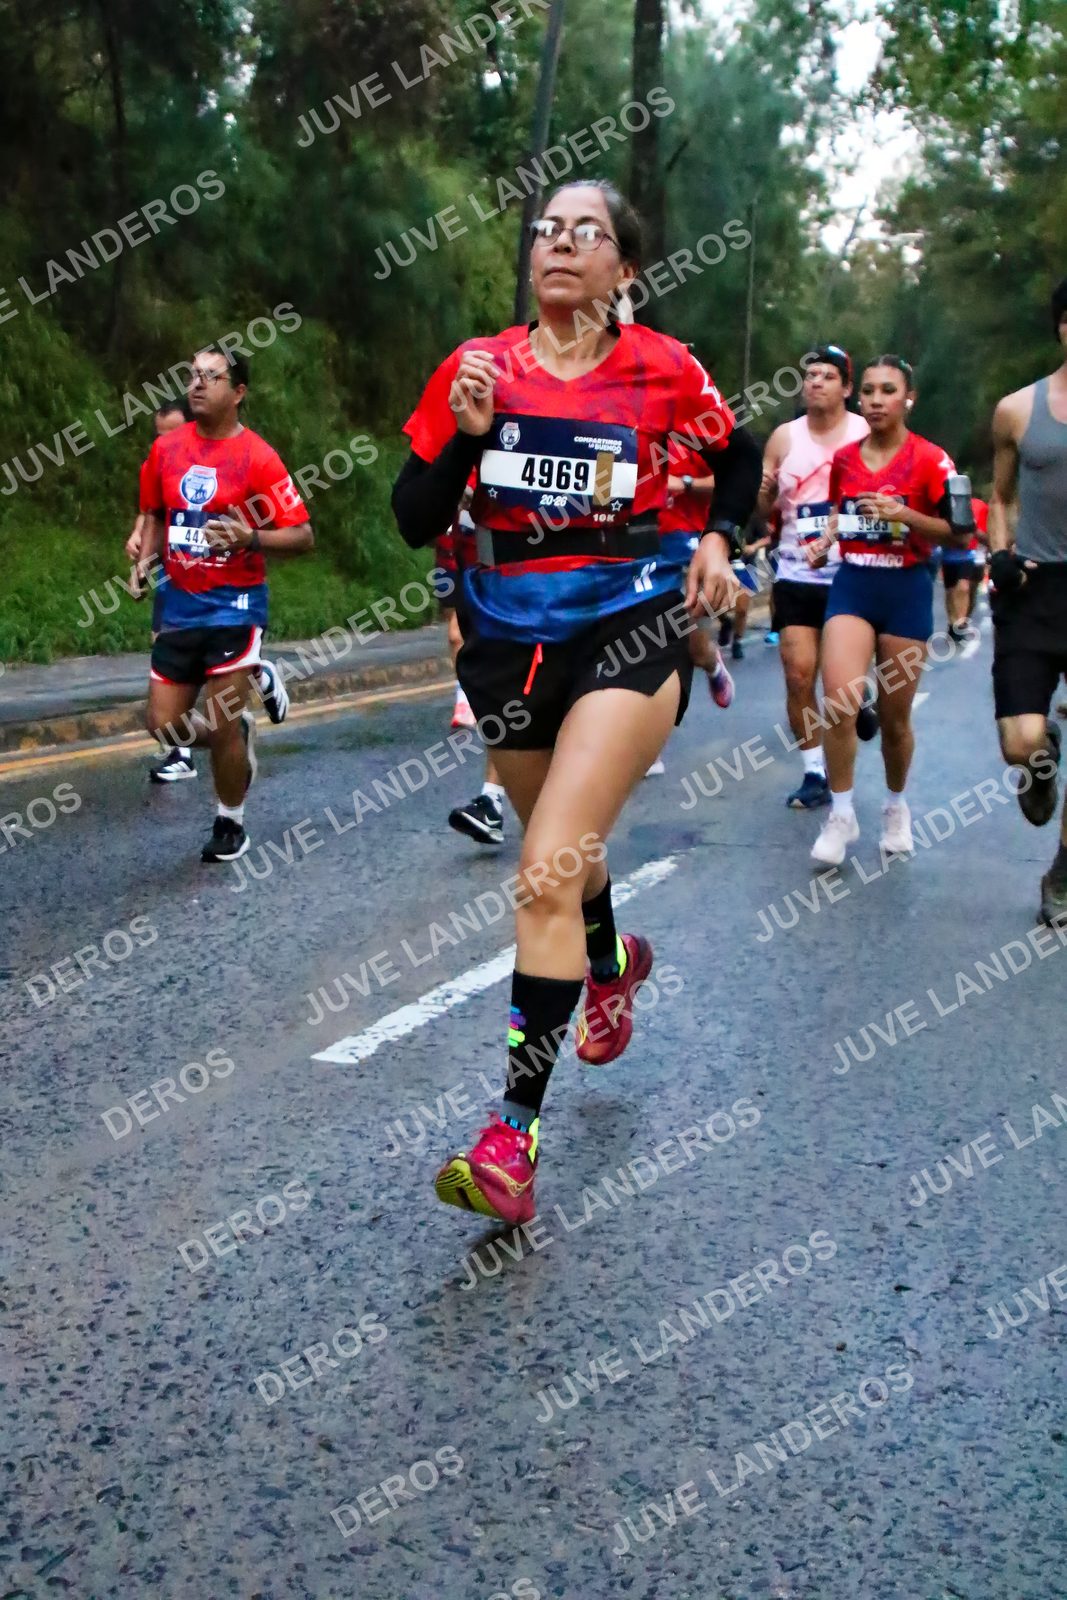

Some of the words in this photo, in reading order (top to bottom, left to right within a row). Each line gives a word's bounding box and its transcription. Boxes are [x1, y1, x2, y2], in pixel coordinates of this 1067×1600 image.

[521, 457, 590, 491] 4969
[540, 494, 568, 507] 20-26
[592, 513, 616, 523] 10K
